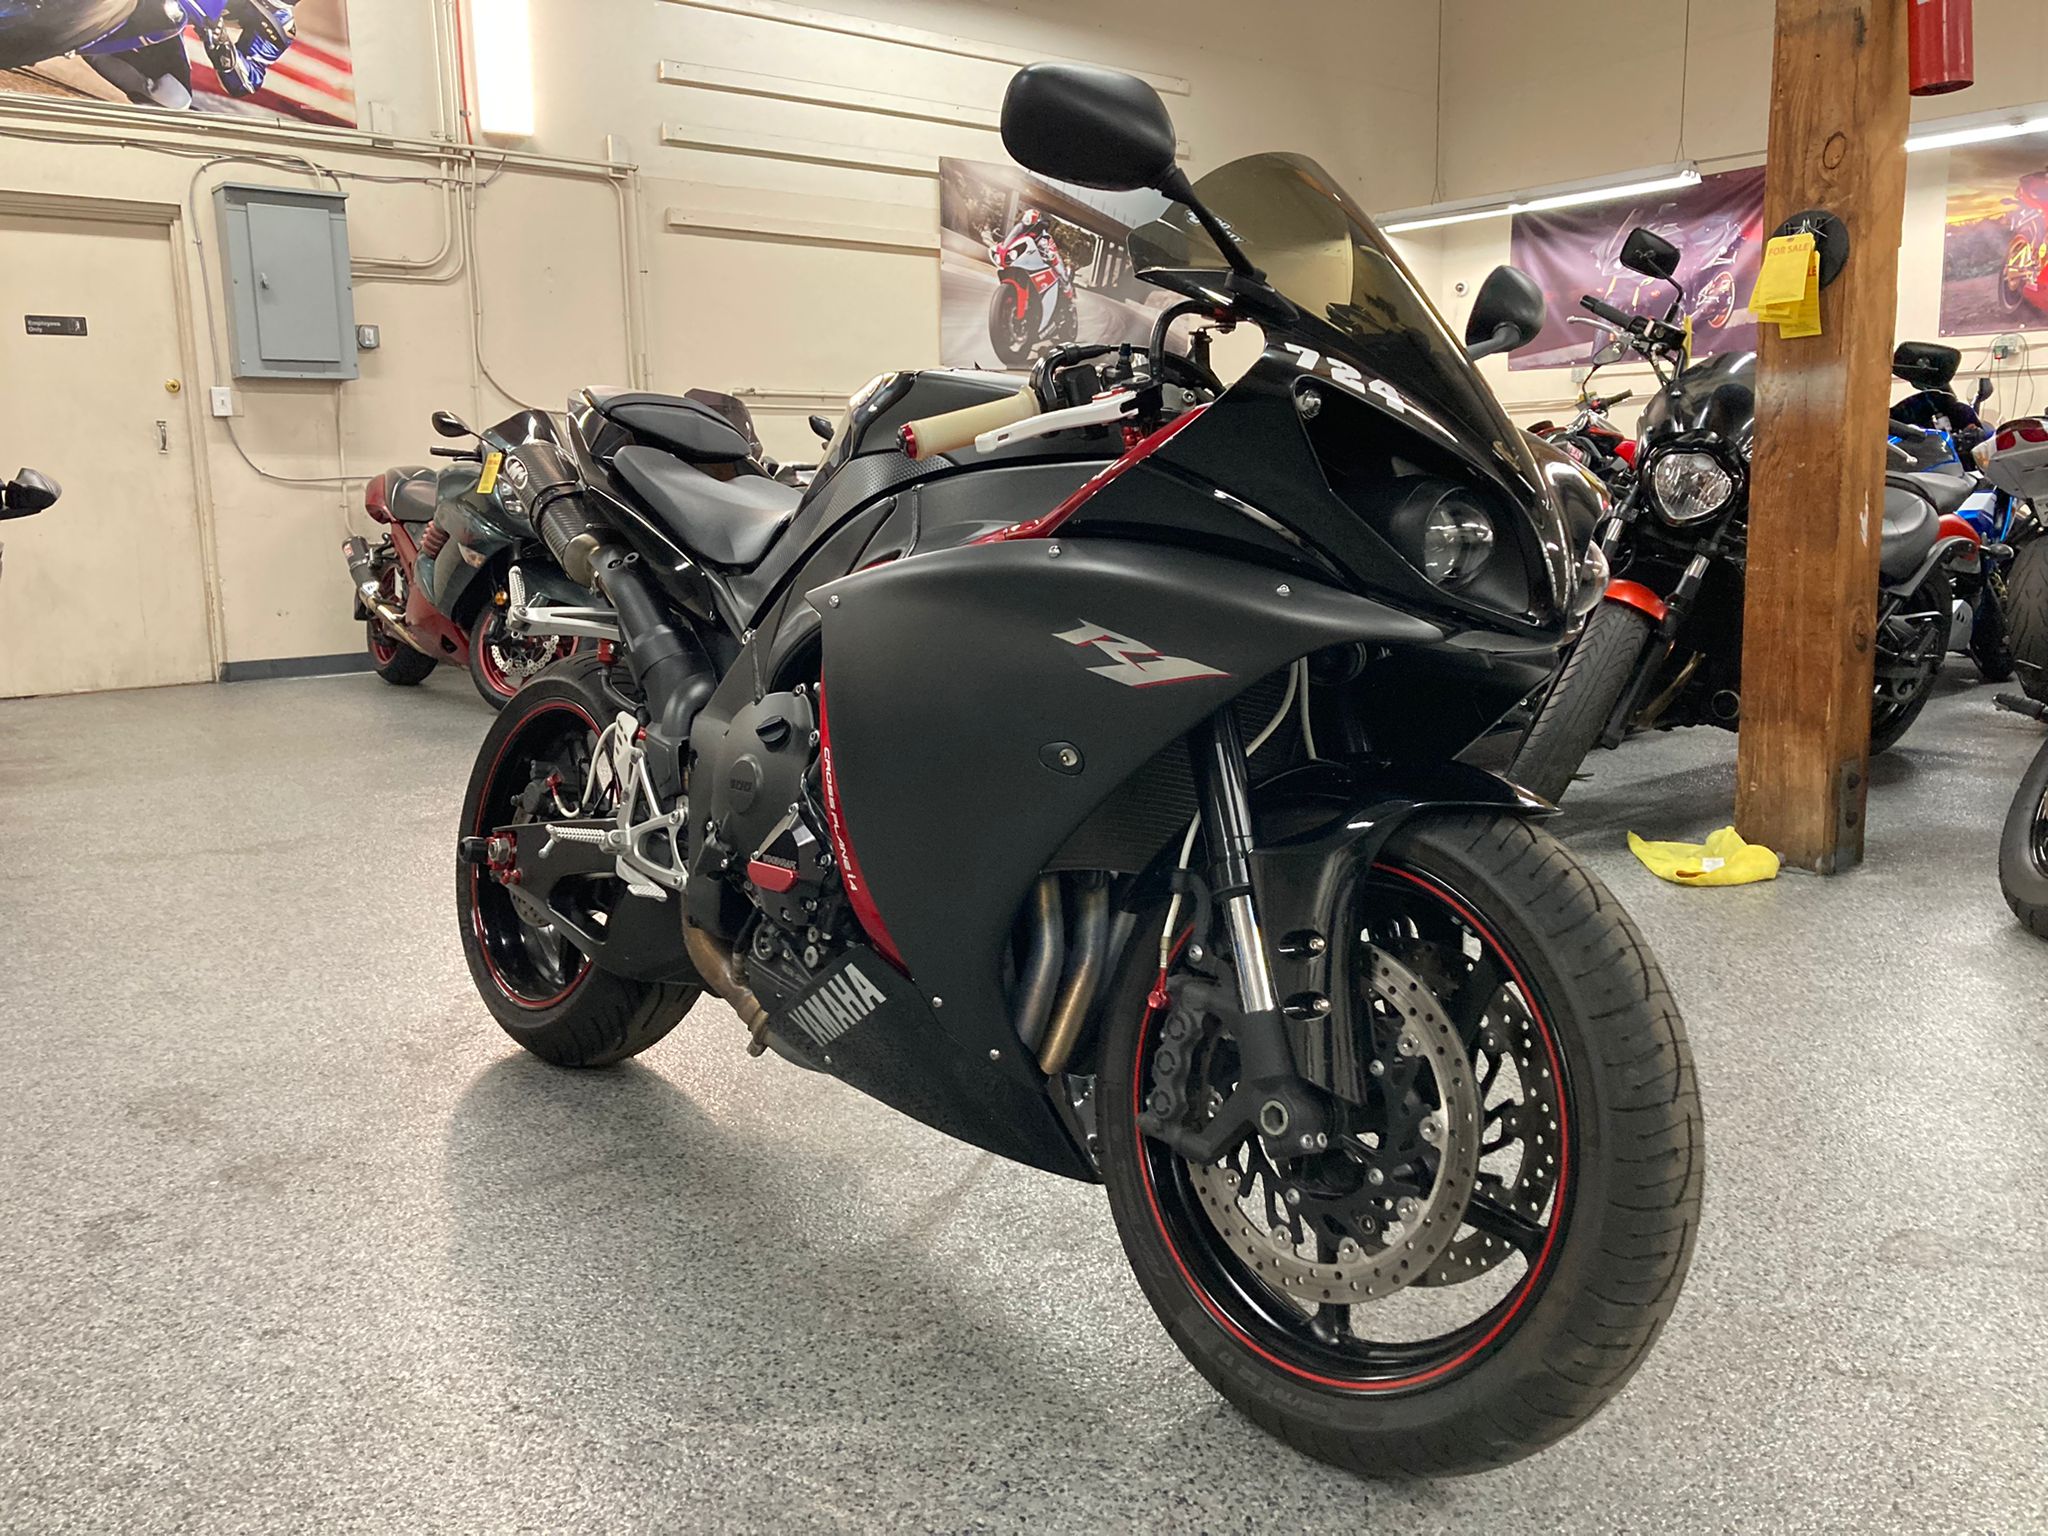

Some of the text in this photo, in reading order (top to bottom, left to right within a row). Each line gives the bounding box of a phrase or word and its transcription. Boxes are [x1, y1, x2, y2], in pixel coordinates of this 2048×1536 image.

[1768, 243, 1809, 256] FOR SALE
[1284, 342, 1405, 414] 724
[823, 747, 837, 810] CROSS
[831, 811, 852, 872] PLANE
[787, 962, 888, 1047] YAMAHA
